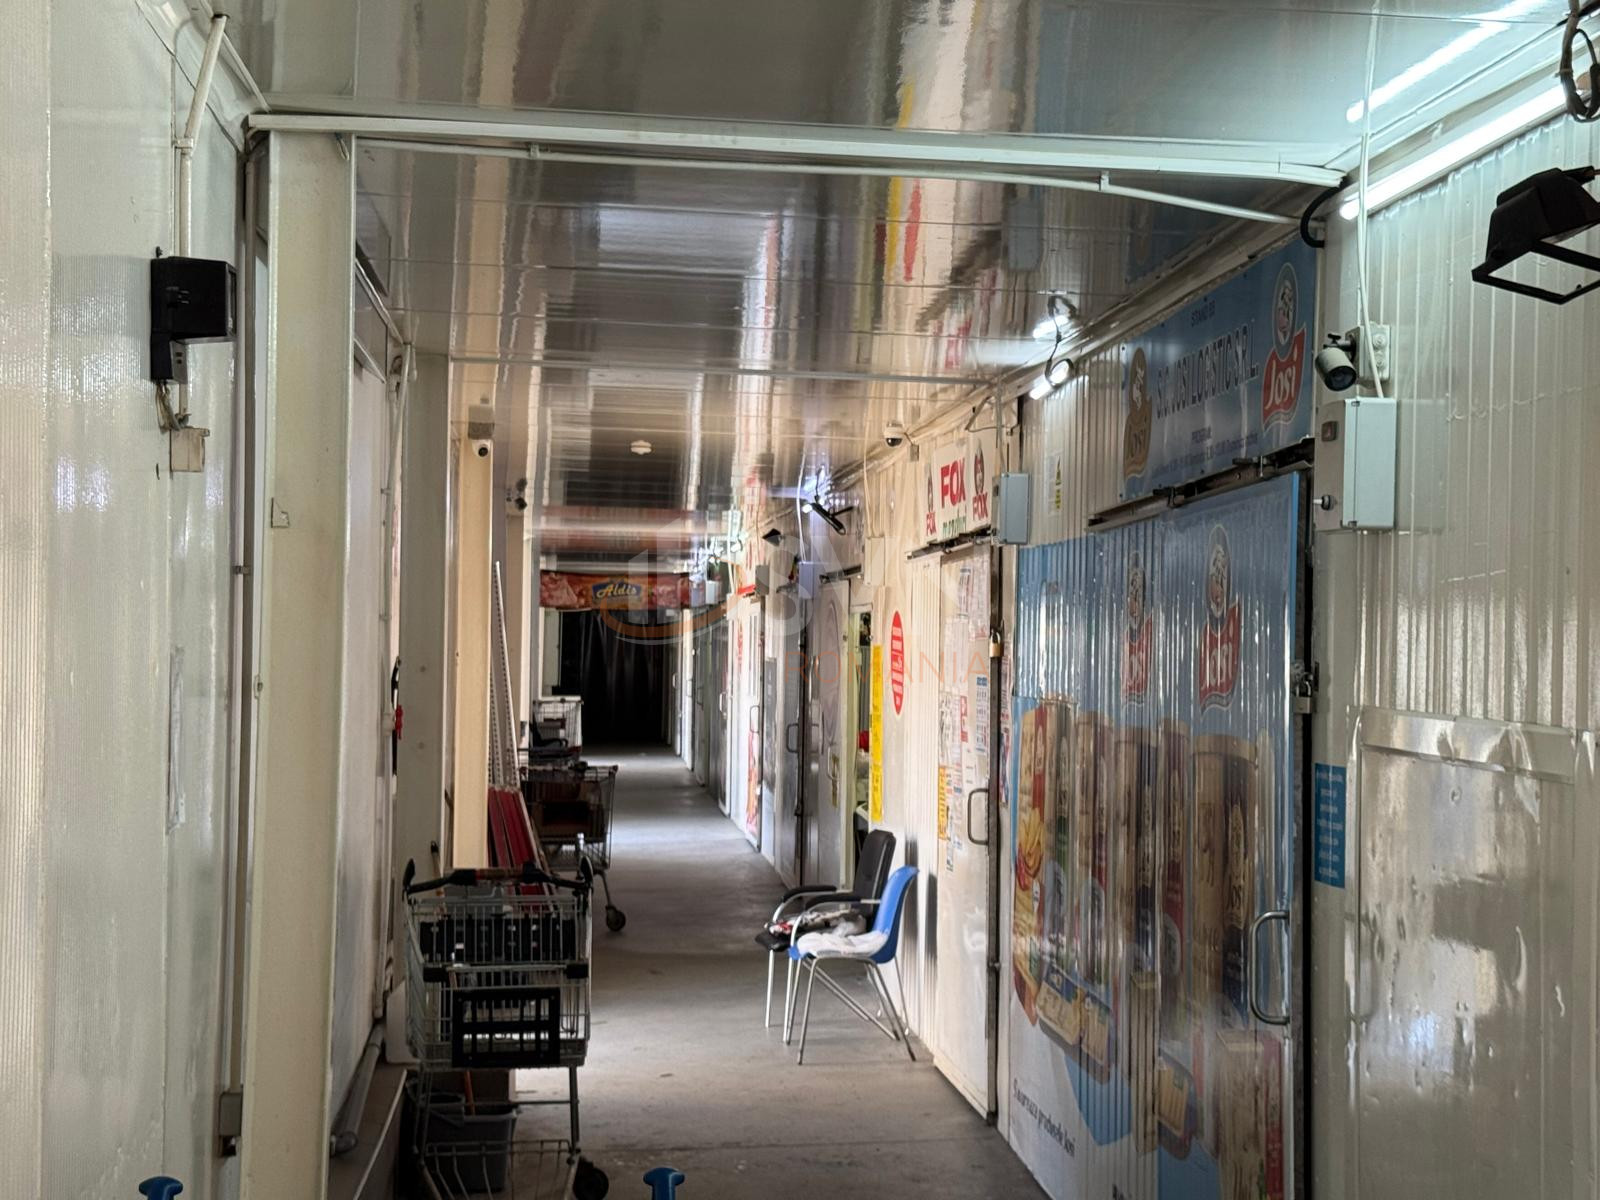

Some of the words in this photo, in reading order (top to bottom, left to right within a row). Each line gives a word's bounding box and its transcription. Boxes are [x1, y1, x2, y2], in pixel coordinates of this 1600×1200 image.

[1265, 350, 1298, 411] Josi
[941, 458, 966, 508] FOX
[973, 492, 988, 520] FOX
[596, 584, 637, 598] Aldis
